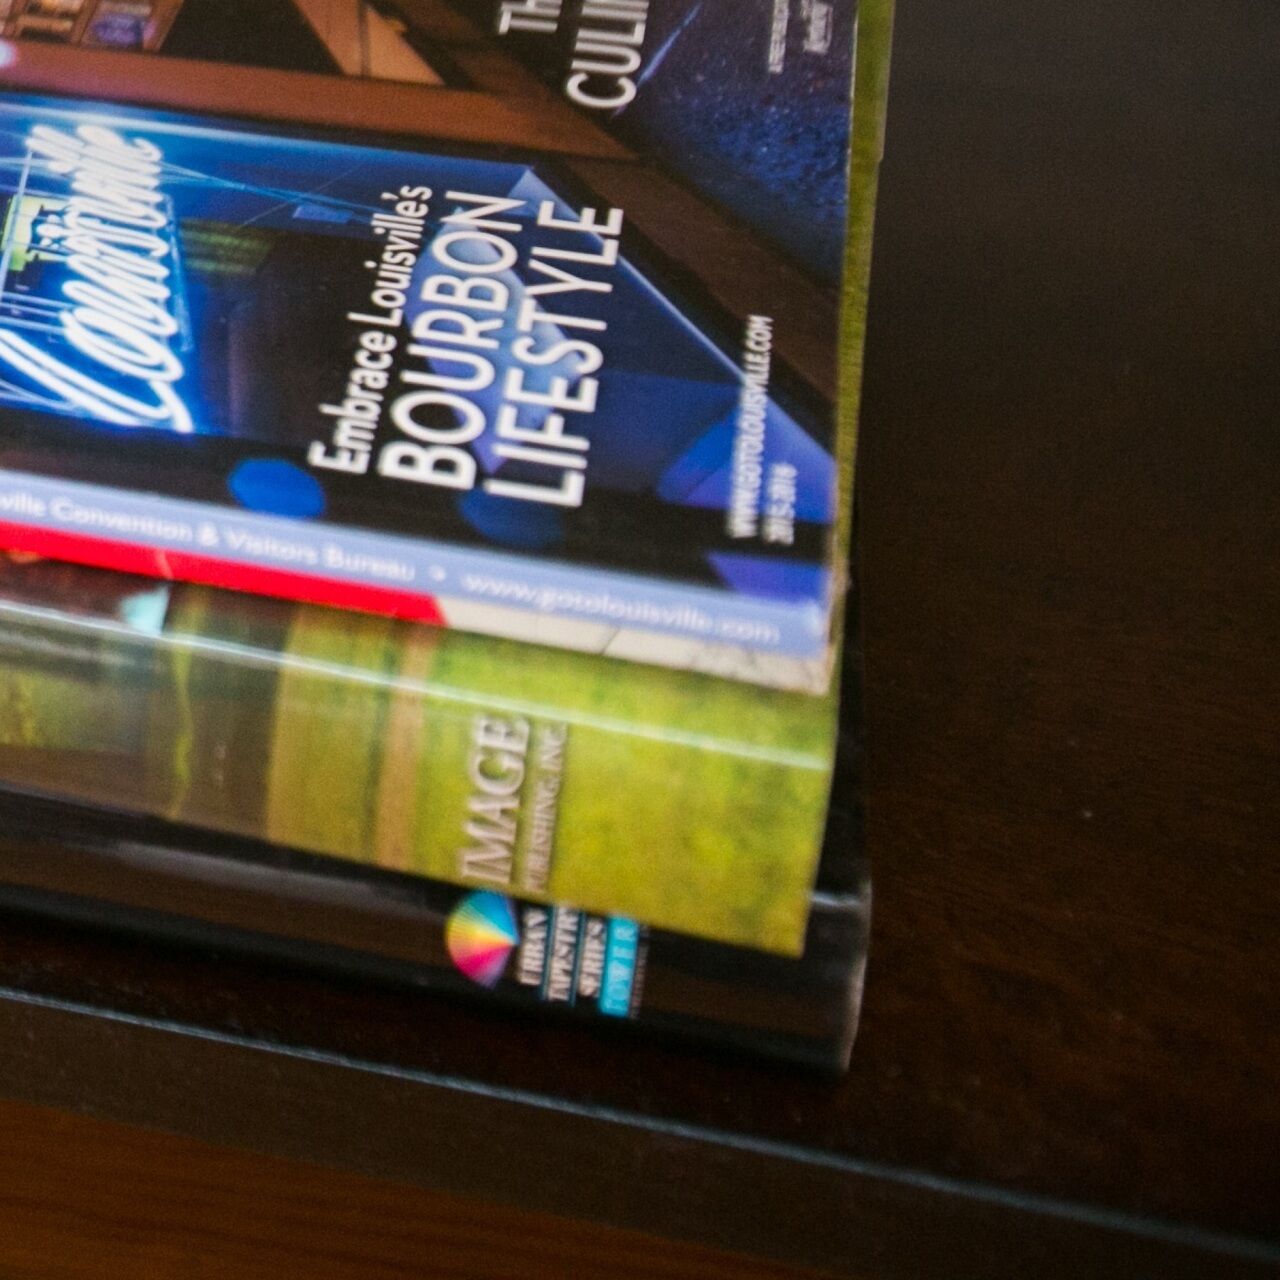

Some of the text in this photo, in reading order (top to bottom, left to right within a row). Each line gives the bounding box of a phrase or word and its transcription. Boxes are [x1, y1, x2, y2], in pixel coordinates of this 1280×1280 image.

[307, 185, 433, 475] Embrace Louisville's
[378, 191, 527, 491] BOURBON
[483, 200, 623, 507] LIFESTYLE
[323, 544, 415, 582] Bureau
[459, 714, 530, 883] IMAGE
